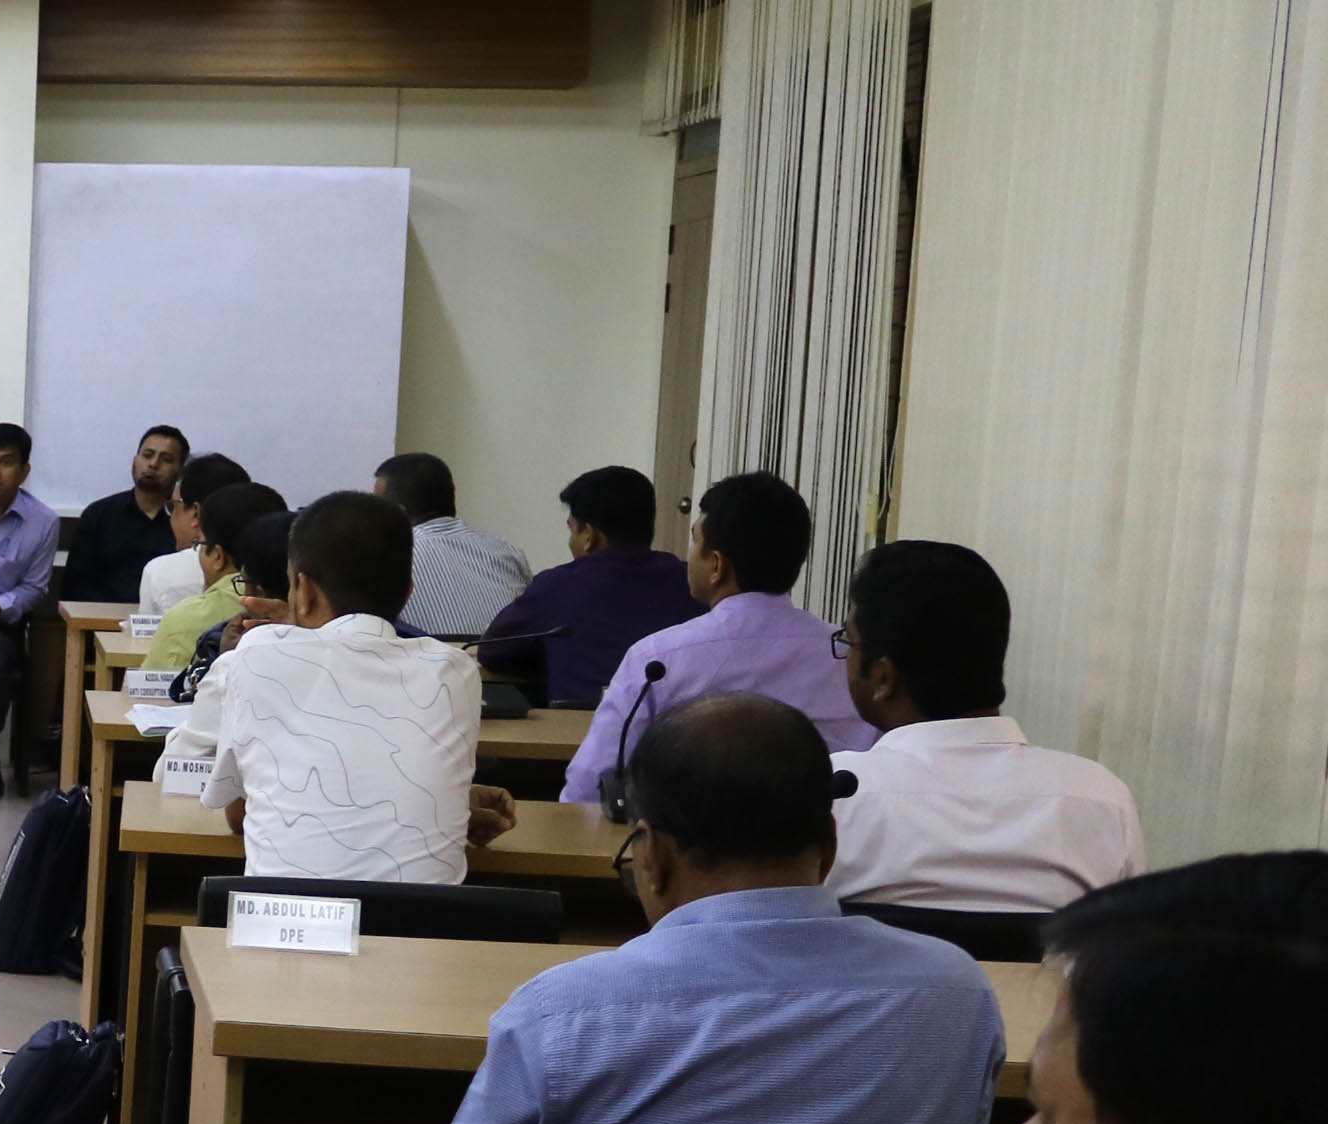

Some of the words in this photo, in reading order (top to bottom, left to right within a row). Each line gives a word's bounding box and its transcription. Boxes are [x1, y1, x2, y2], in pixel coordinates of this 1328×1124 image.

[167, 760, 181, 772] MD.
[183, 761, 213, 774] MOSHIU
[237, 900, 259, 915] MD.
[264, 902, 306, 918] ABDUL
[310, 903, 345, 920] LATIF
[280, 928, 305, 943] DPE
